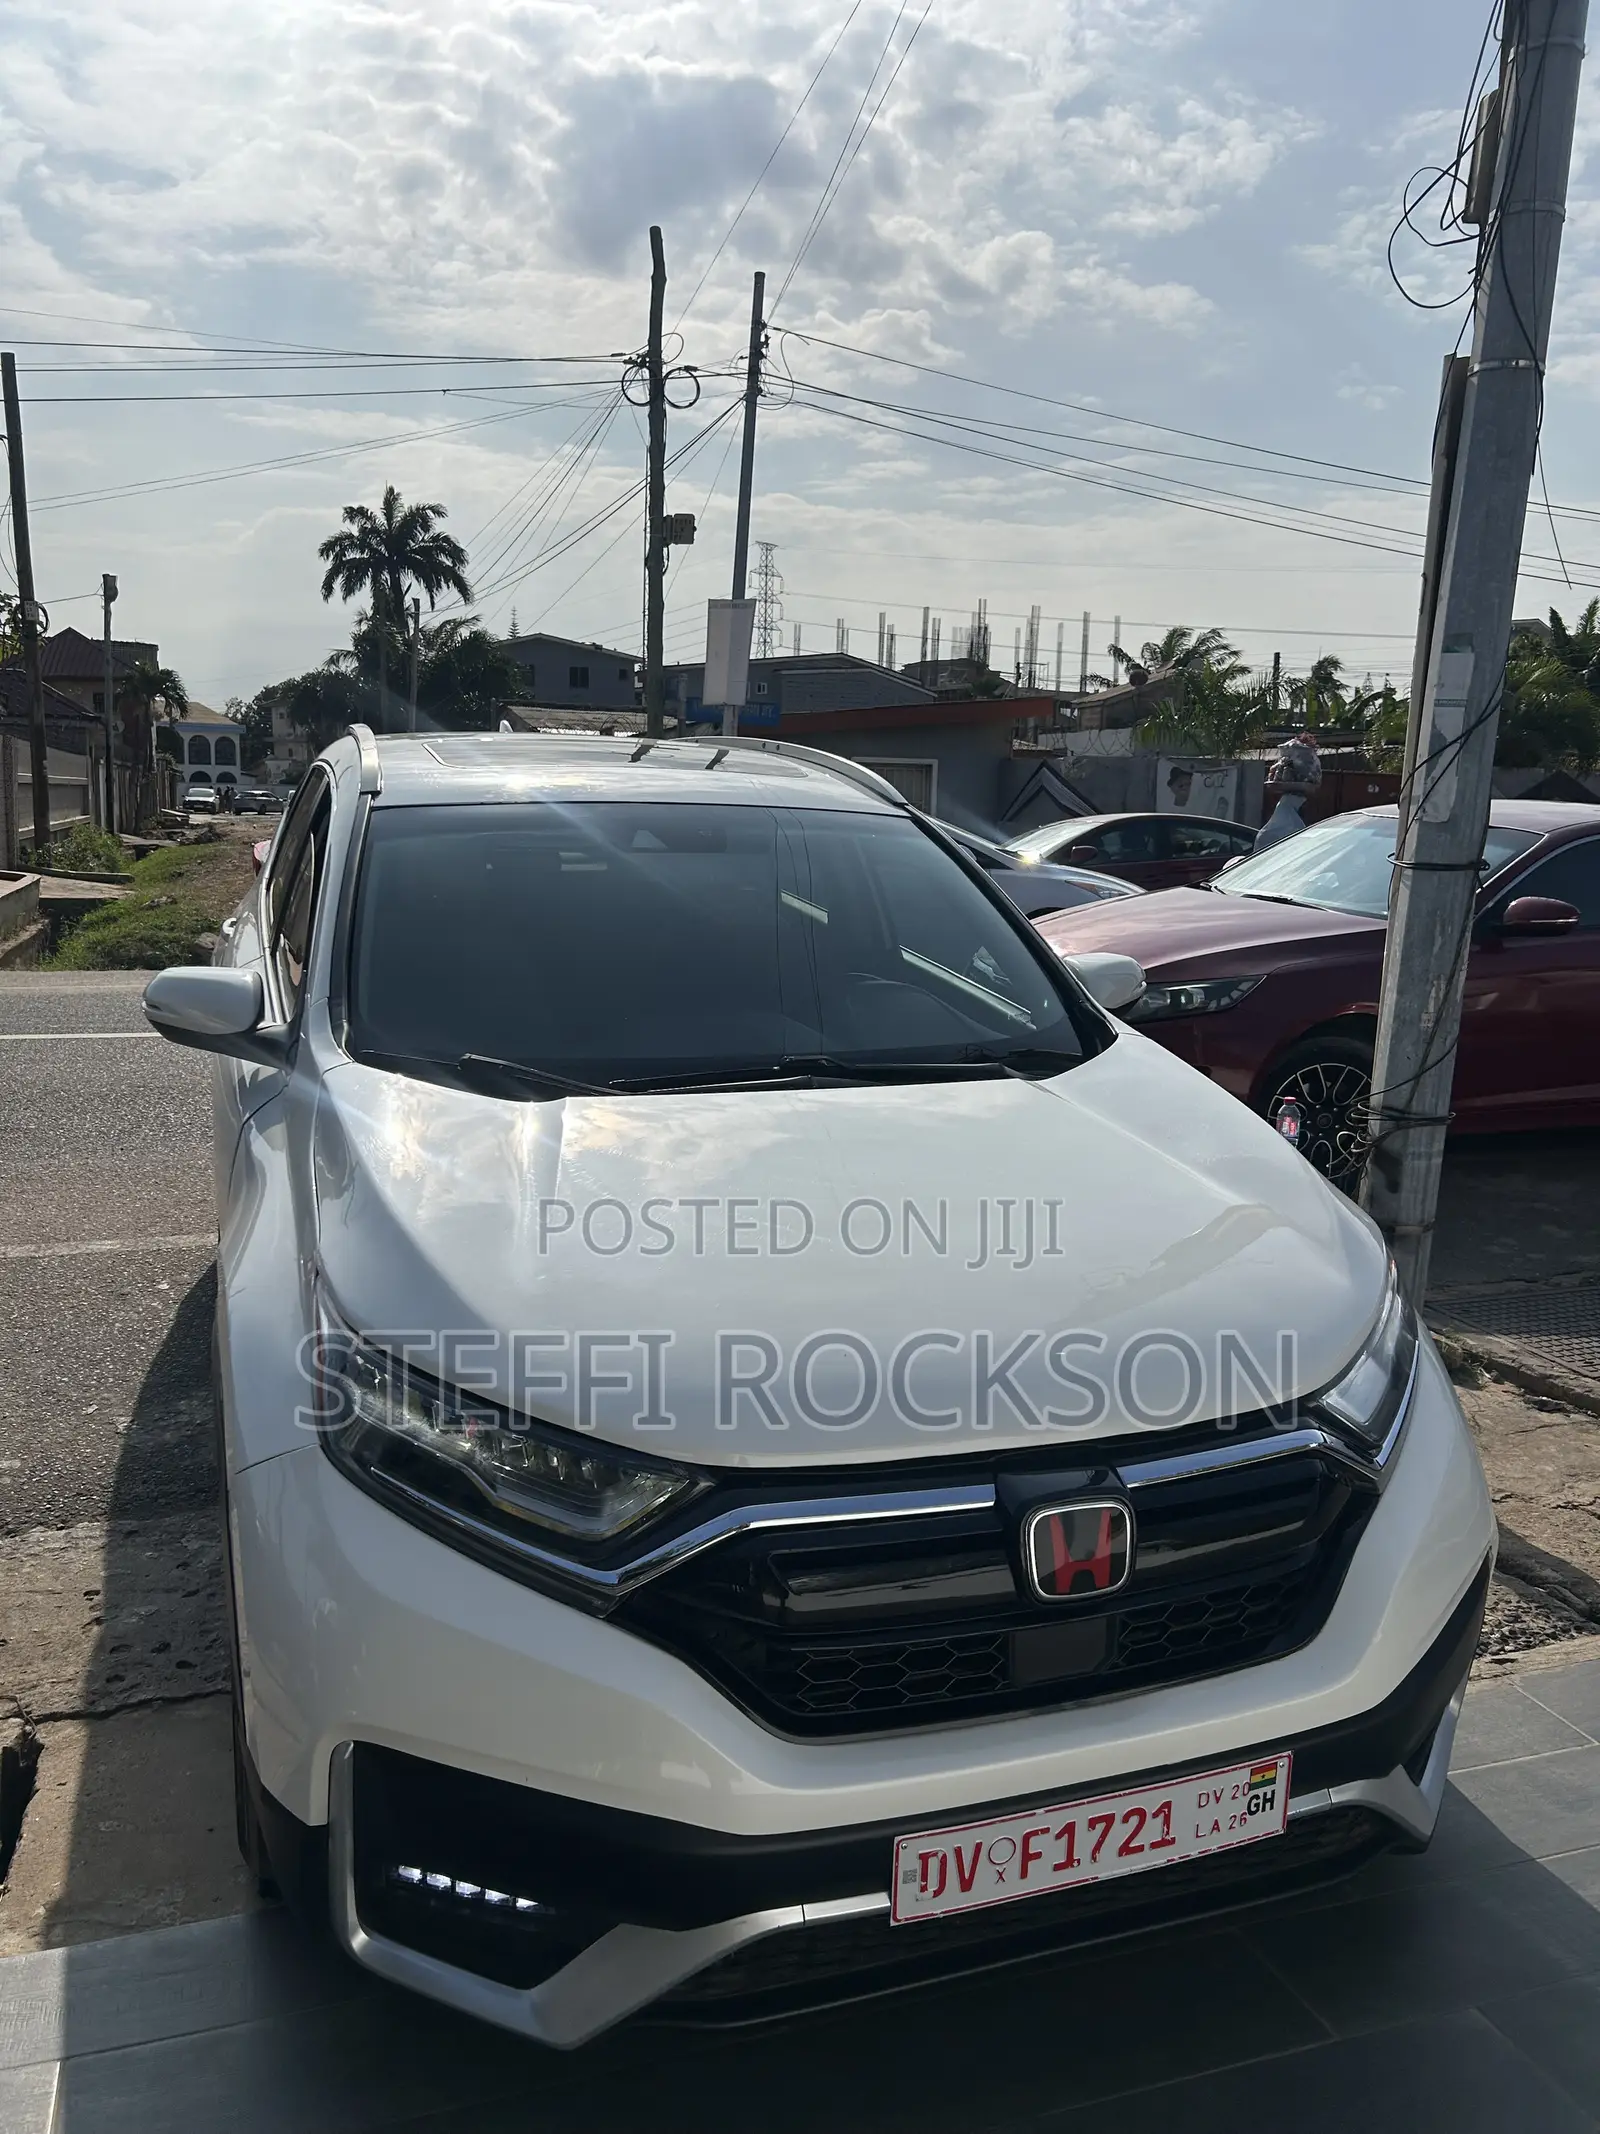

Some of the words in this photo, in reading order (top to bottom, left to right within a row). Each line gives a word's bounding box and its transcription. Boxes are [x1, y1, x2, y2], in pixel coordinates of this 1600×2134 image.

[1197, 1785, 1224, 1809] DV
[1231, 1780, 1251, 1801] 20
[1246, 1788, 1276, 1816] GH
[1195, 1817, 1221, 1839] LA
[1228, 1811, 1248, 1831] 26
[917, 1841, 983, 1900] DV
[1020, 1799, 1176, 1881] F1721
